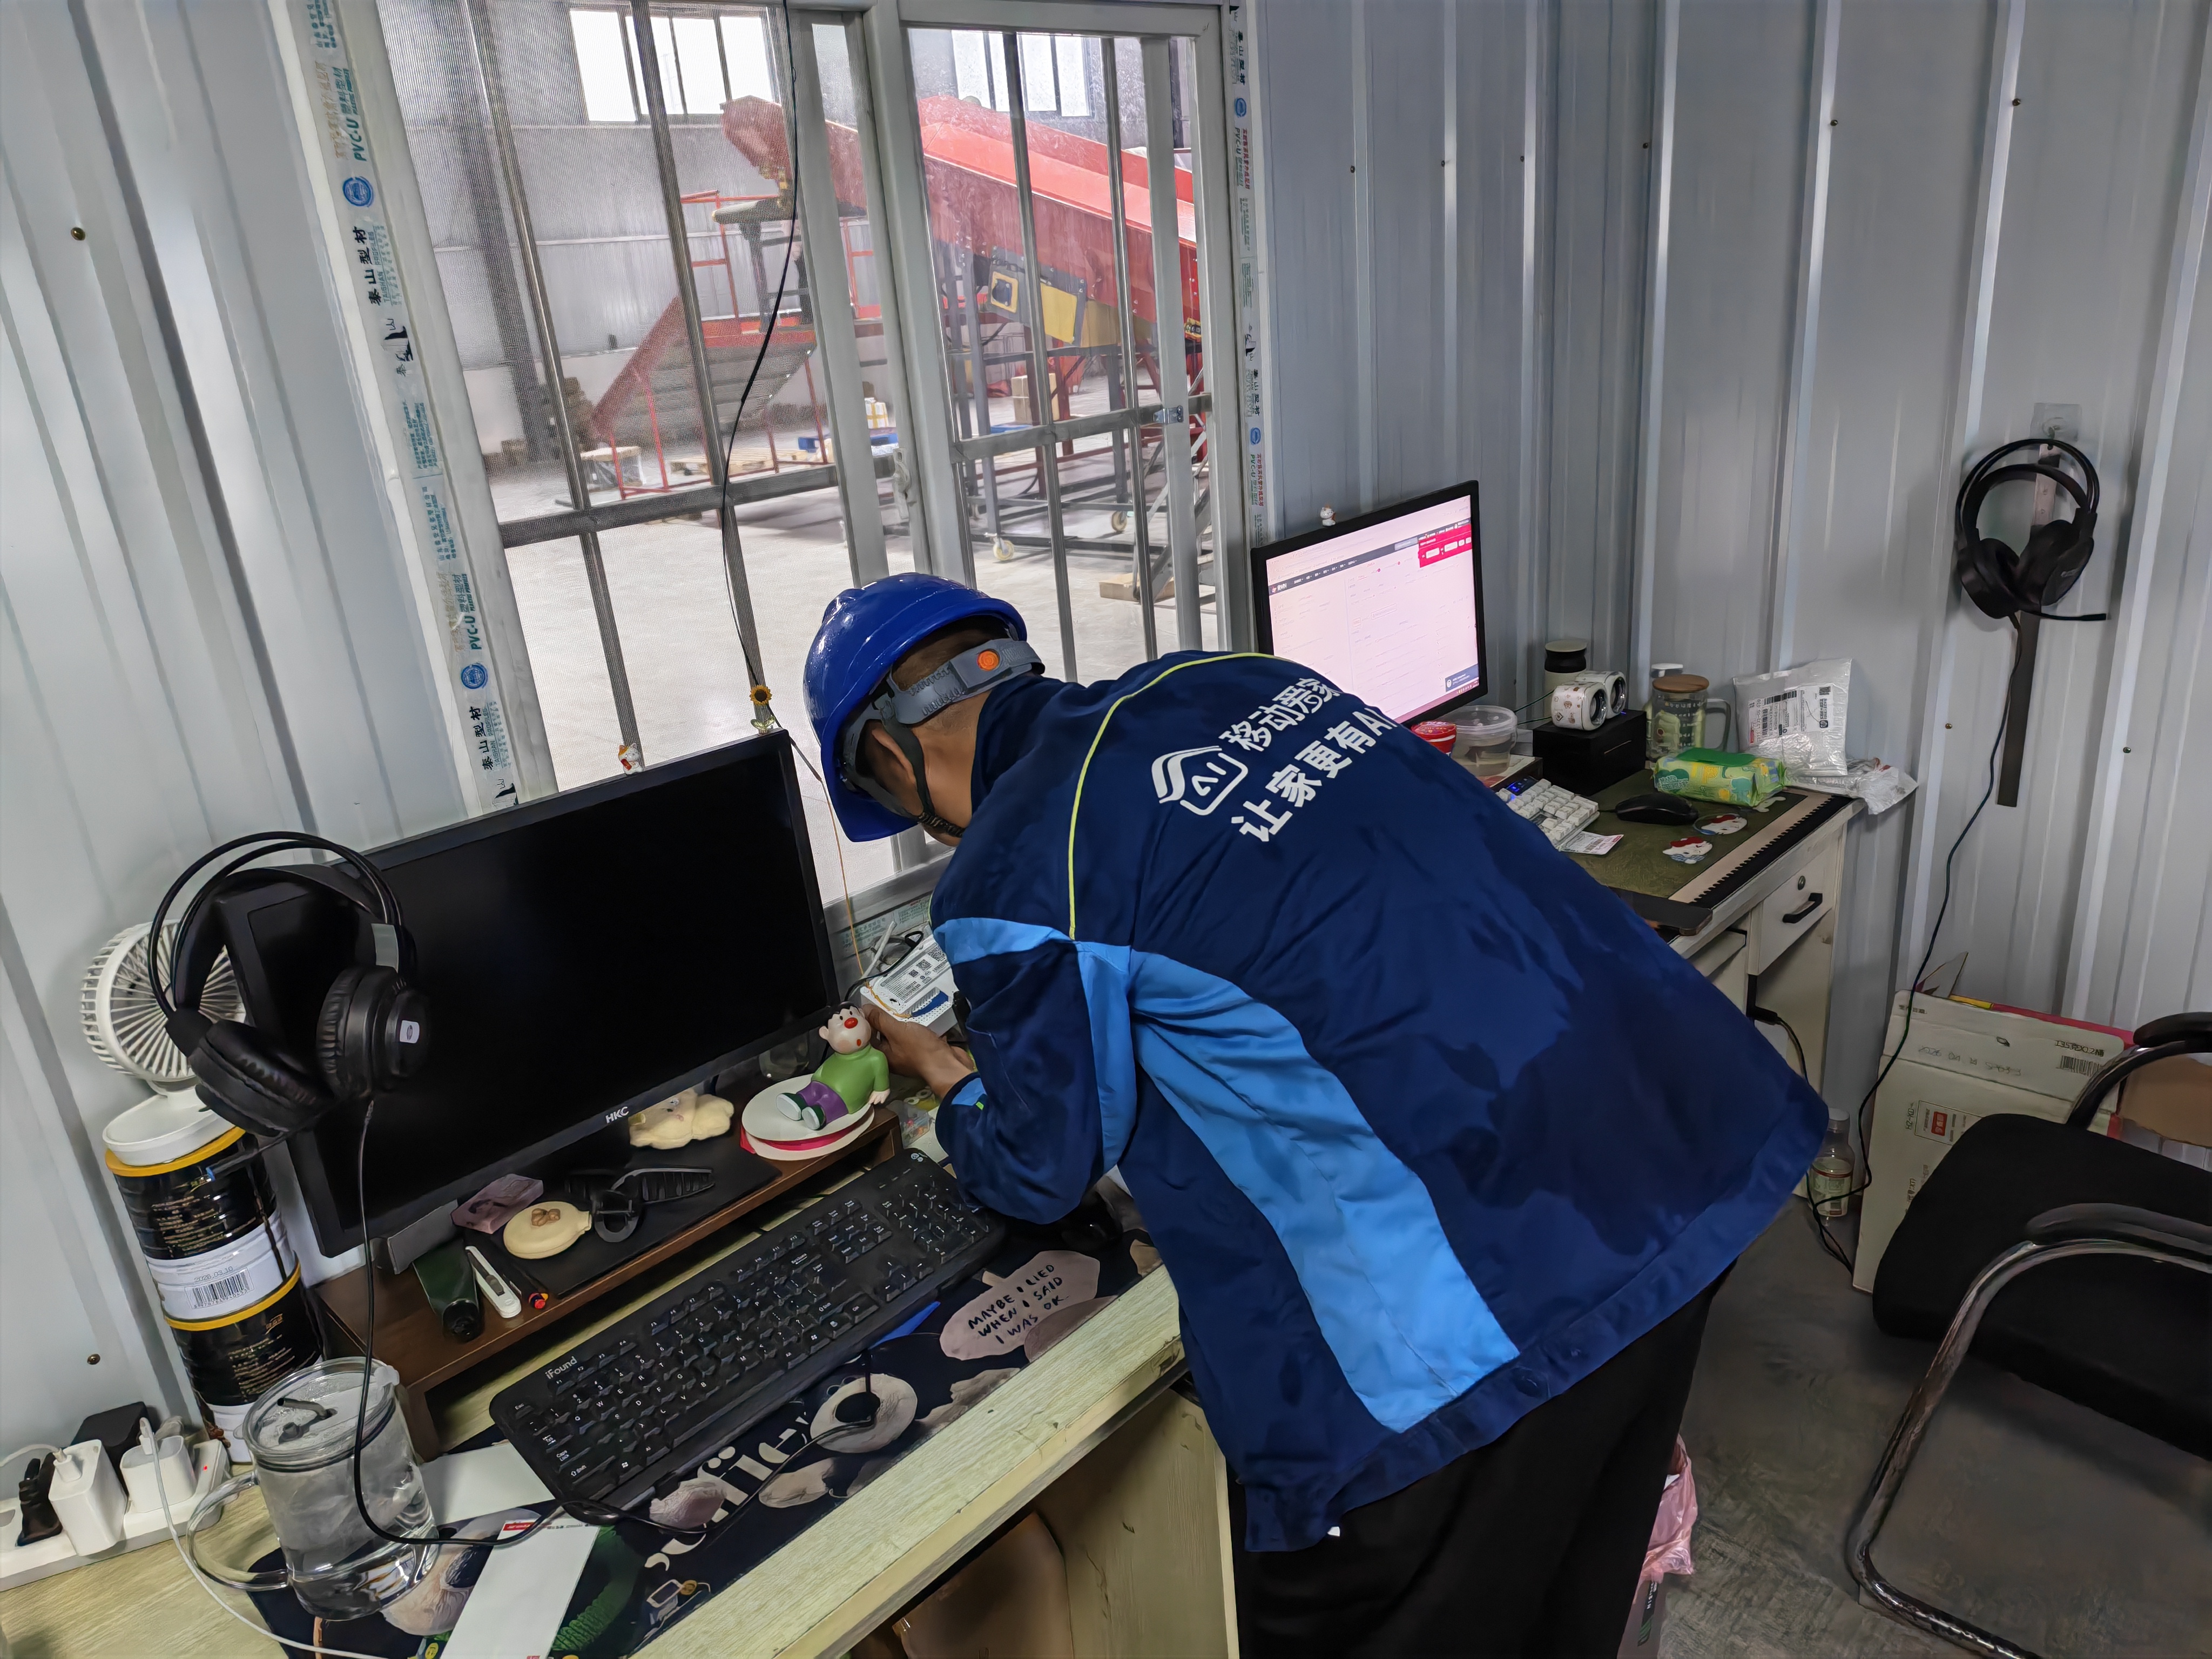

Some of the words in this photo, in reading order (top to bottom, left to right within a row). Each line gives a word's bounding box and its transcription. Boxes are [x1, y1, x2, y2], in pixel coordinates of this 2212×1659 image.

[352, 226, 381, 306] 泰山型材
[464, 616, 482, 650] PVC-U
[469, 706, 494, 771] 泰山型材
[1218, 678, 1340, 752] 移动爱家
[605, 1106, 629, 1124] HKC
[968, 1294, 1015, 1330] MAYBE
[1026, 1265, 1055, 1285] LIED
[978, 1307, 1017, 1337] WHEN
[1034, 1277, 1063, 1301] SAID
[995, 1335, 1004, 1344] I
[1007, 1314, 1038, 1336] WAS
[545, 1355, 578, 1380] iFound
